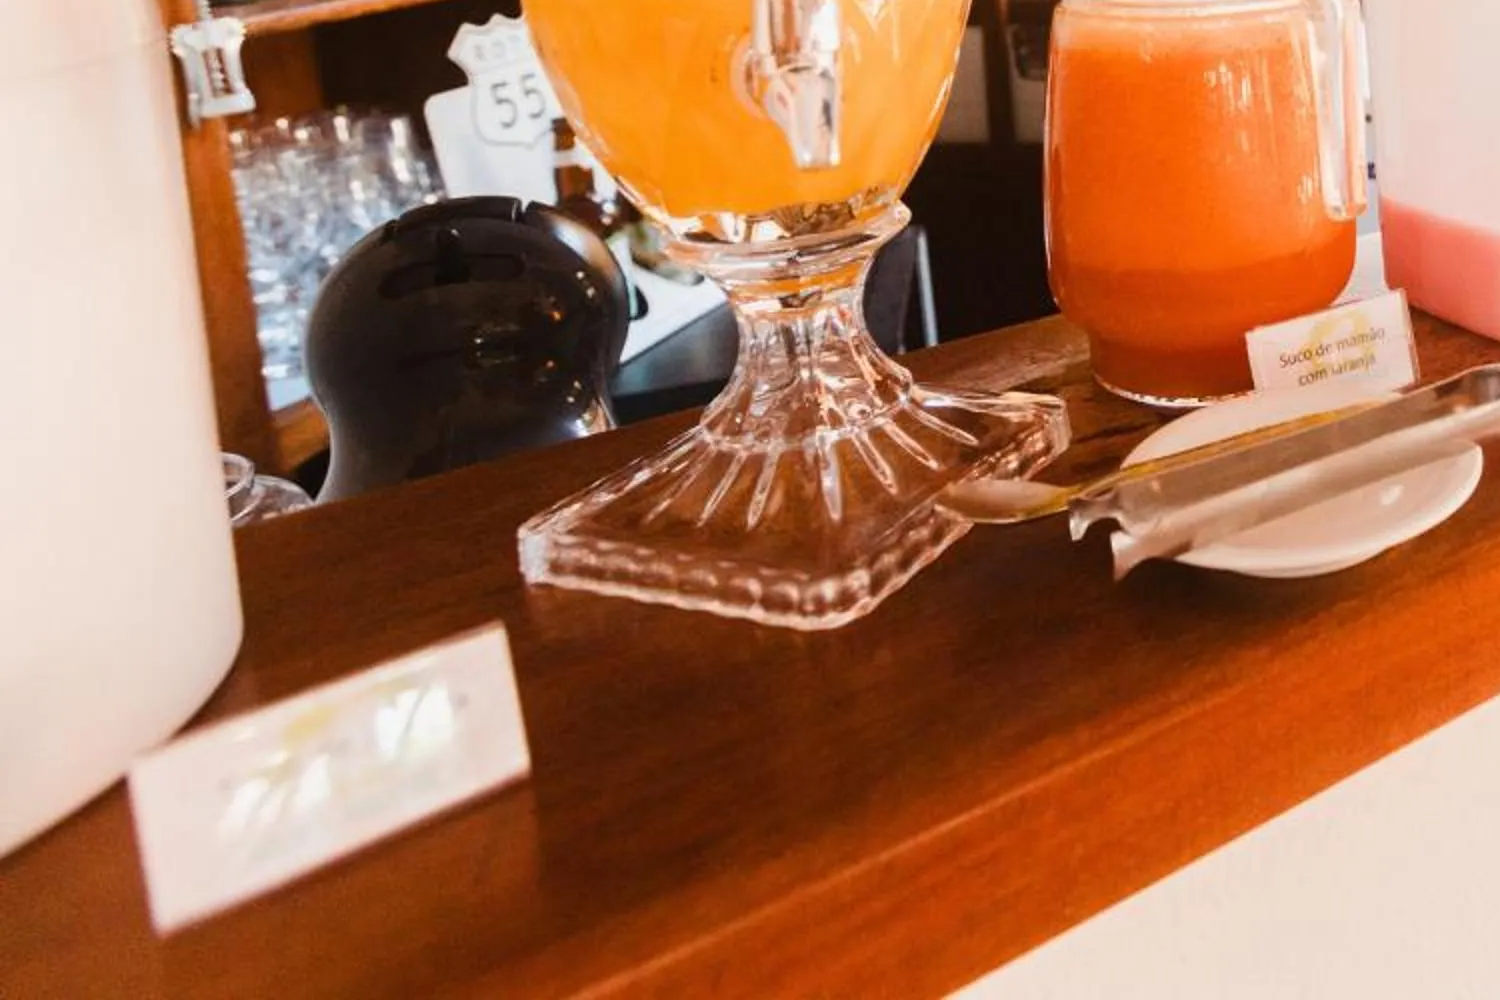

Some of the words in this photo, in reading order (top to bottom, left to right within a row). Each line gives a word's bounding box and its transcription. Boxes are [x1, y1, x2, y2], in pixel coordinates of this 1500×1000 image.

[490, 72, 546, 129] 55
[1279, 347, 1313, 369] Suco
[1315, 342, 1333, 357] de
[1298, 367, 1328, 387] com
